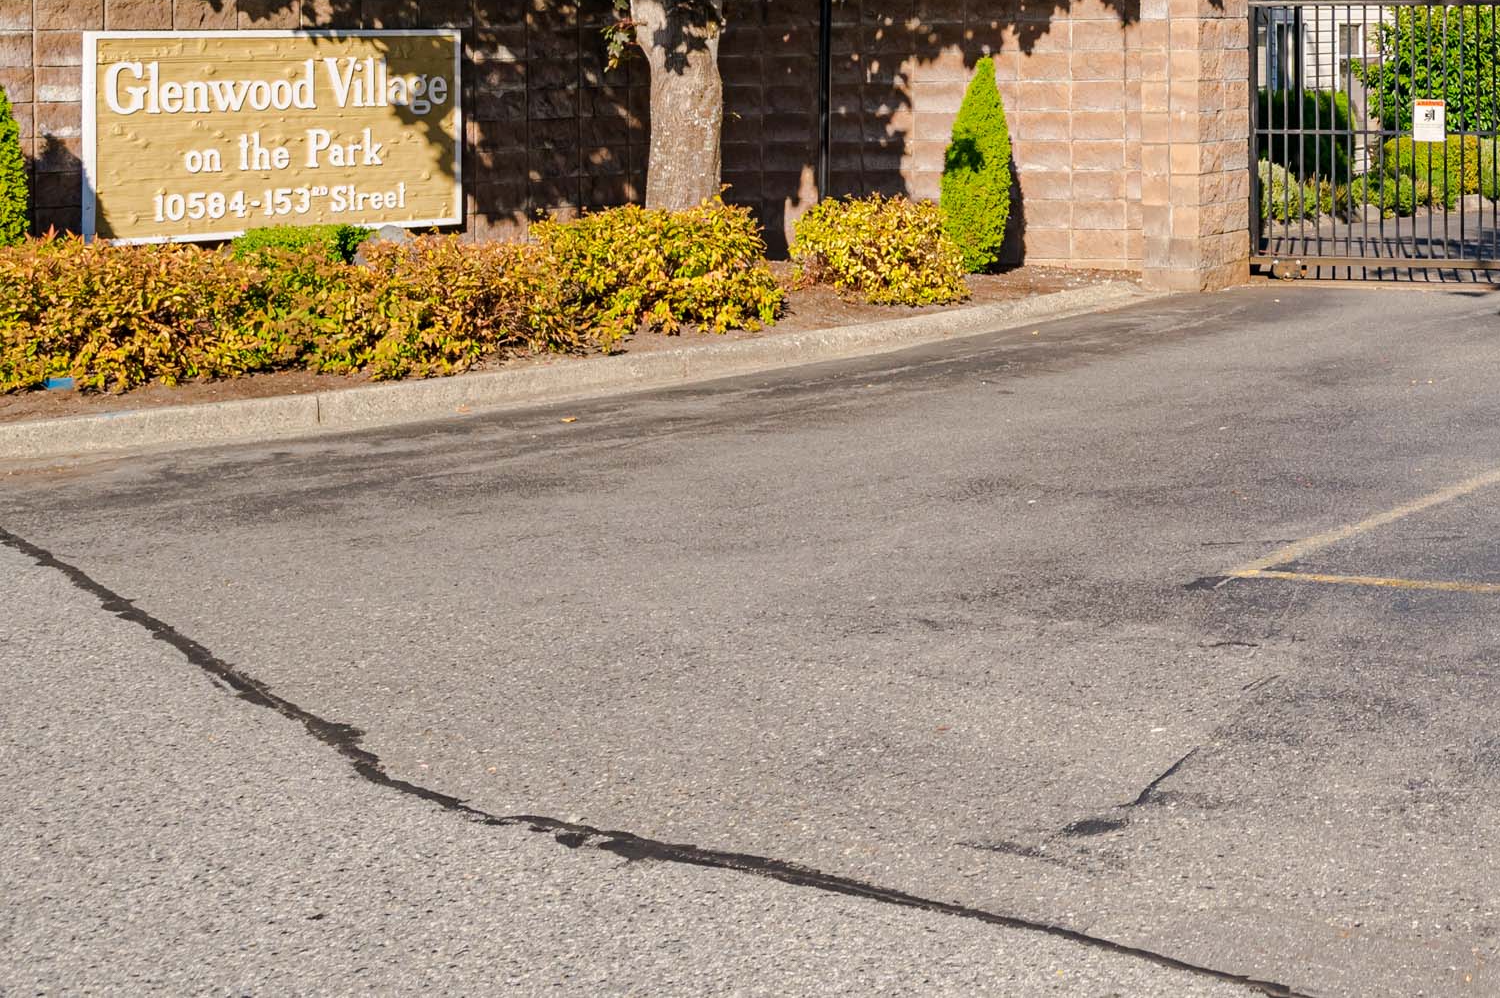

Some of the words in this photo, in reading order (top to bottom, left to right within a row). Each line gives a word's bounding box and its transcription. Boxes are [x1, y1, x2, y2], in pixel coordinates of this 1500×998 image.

[104, 59, 317, 115] Glenwood
[323, 57, 448, 115] Village
[185, 148, 222, 173] on
[238, 131, 290, 171] the
[306, 128, 384, 169] Park
[330, 181, 406, 212] Street
